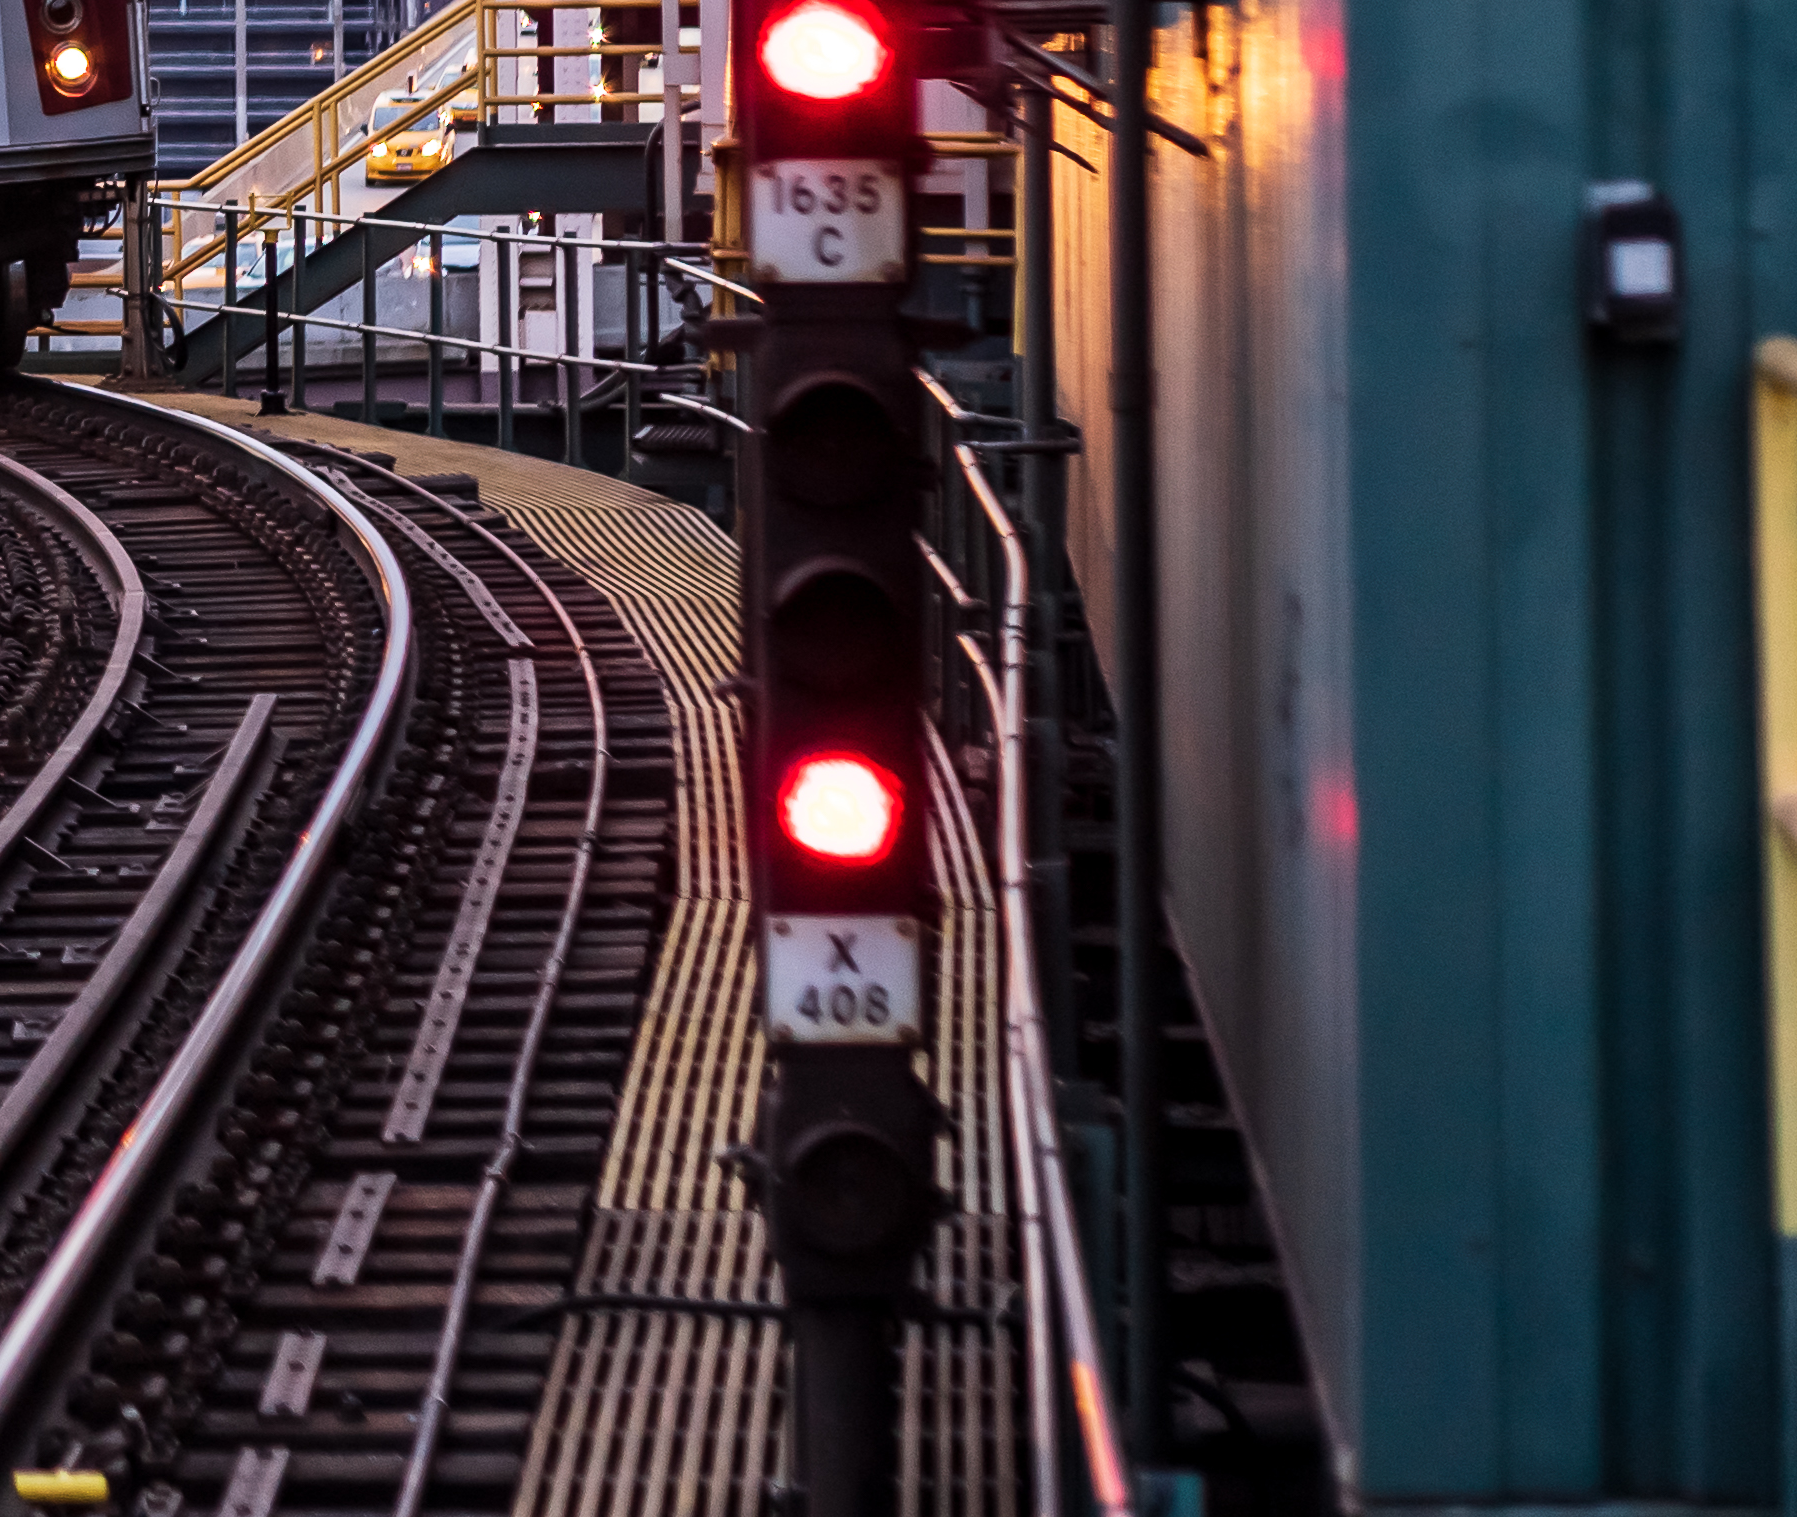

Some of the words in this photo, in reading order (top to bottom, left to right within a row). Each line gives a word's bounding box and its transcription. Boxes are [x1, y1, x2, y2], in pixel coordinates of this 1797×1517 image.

[773, 173, 882, 216] 1635
[811, 225, 845, 268] C
[825, 932, 862, 975] X
[796, 983, 891, 1027] 408
